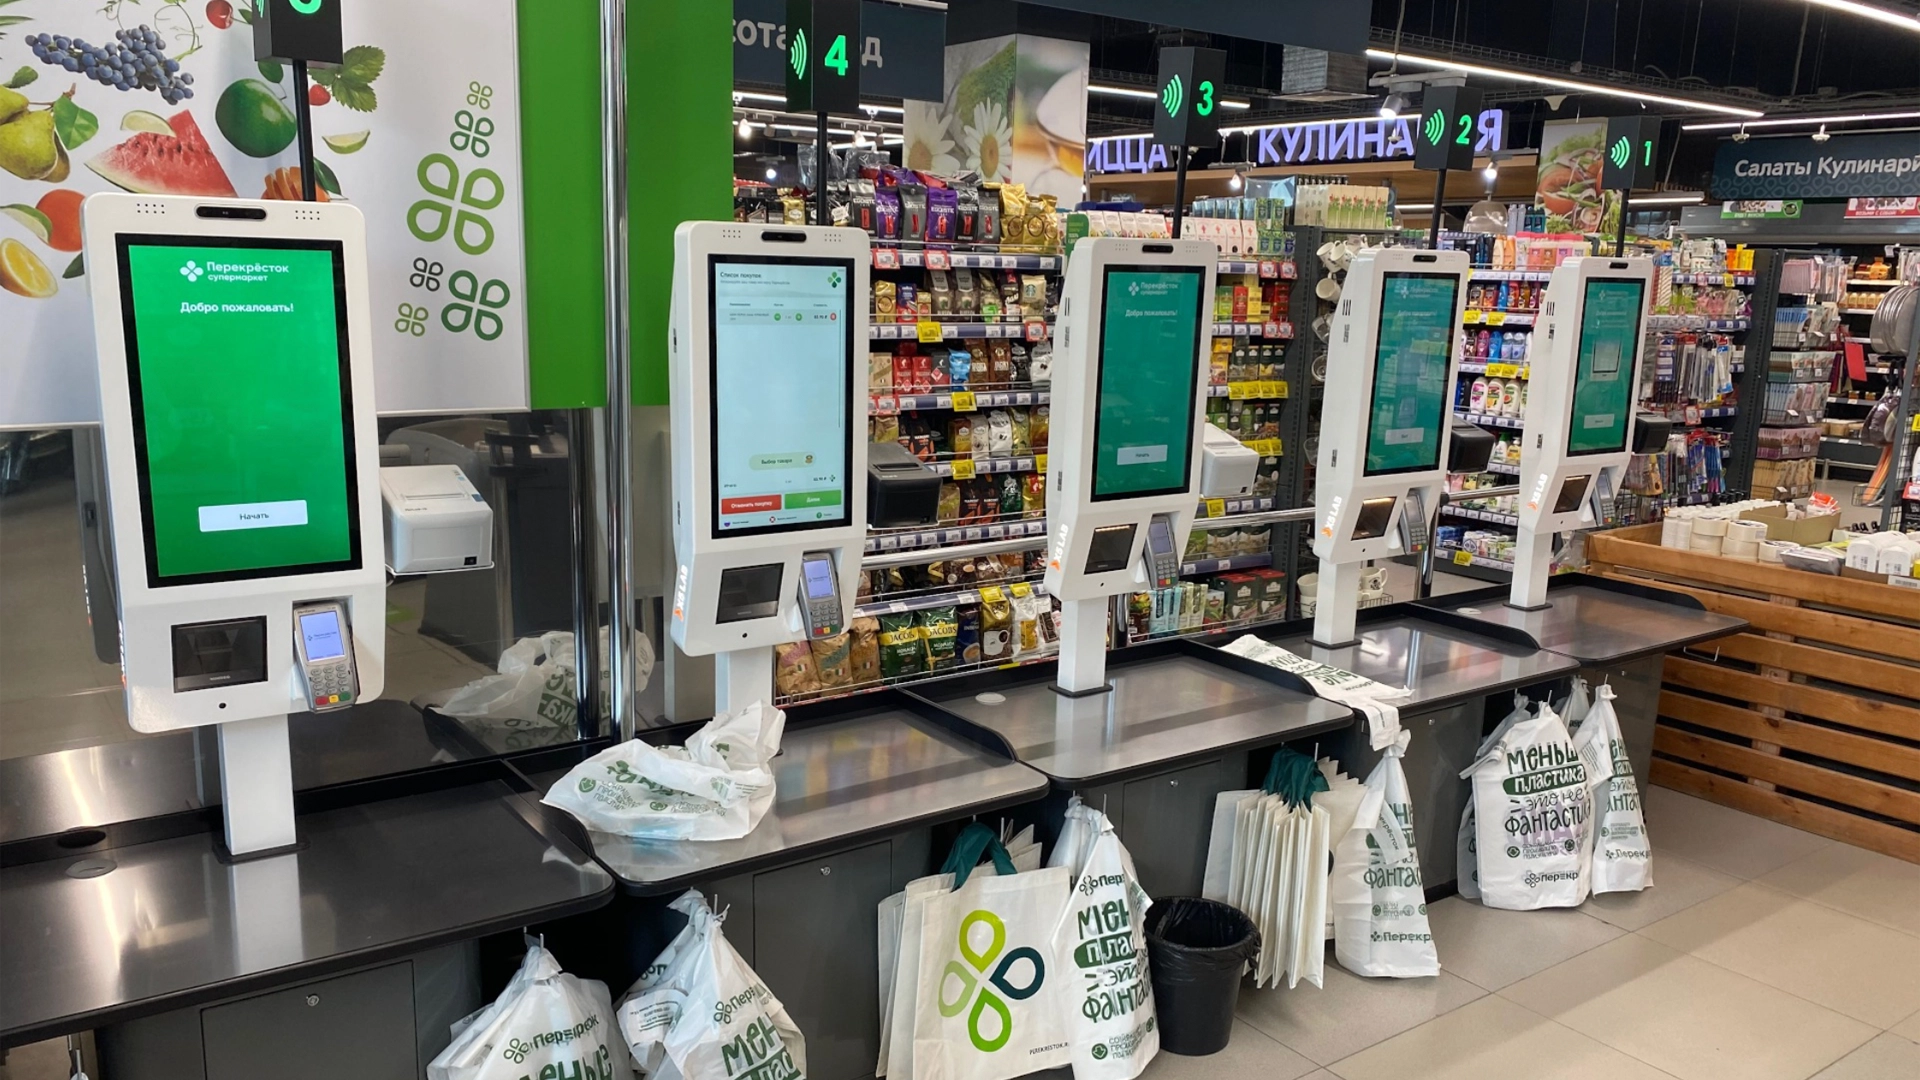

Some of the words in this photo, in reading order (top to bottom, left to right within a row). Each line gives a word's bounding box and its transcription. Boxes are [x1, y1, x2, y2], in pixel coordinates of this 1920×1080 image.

[824, 34, 848, 76] 4
[1196, 81, 1214, 116] 3
[1456, 115, 1472, 145] 2
[1644, 141, 1652, 166] 1
[1735, 158, 1812, 177] Салаты
[206, 261, 289, 274] Перекрёсток
[720, 271, 739, 279] Список
[208, 274, 268, 282] супермаркет
[1140, 282, 1178, 290] Перекрёсток
[180, 302, 219, 314] Добро
[221, 303, 294, 313] пожаловать!
[1125, 309, 1143, 317] Добро
[1535, 473, 1548, 493] LAB
[1329, 495, 1342, 516] LAB
[239, 511, 270, 521] Начать
[1057, 523, 1069, 548] LAB
[679, 564, 688, 592] LAB
[929, 625, 957, 637] JACOBS
